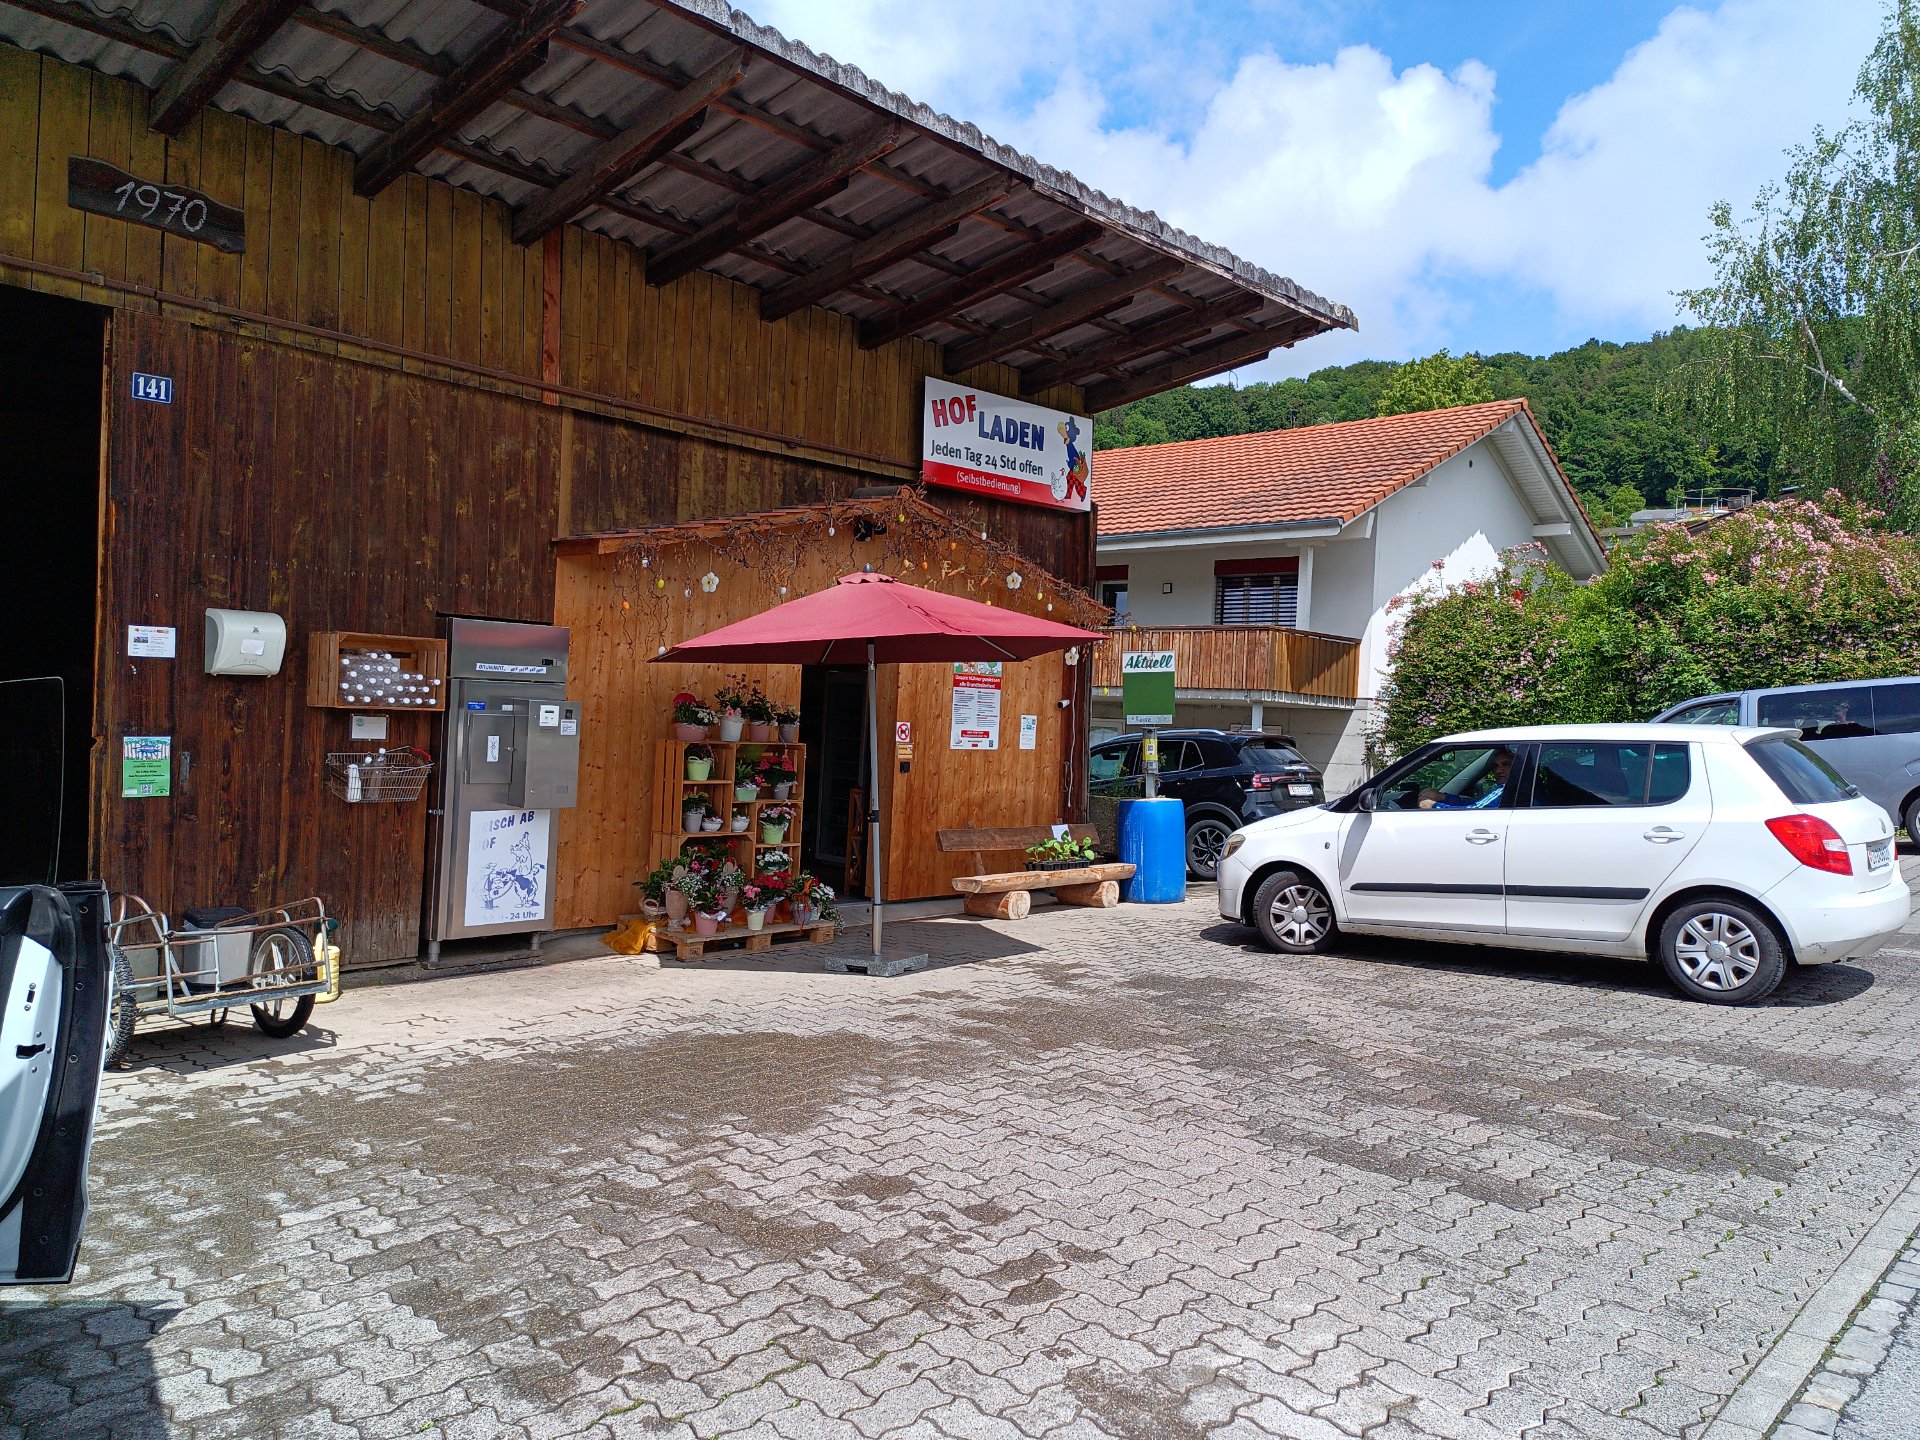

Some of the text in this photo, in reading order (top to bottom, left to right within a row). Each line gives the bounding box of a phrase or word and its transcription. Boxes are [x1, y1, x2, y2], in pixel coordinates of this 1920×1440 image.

[115, 181, 208, 232] 1970
[137, 376, 167, 400] 141
[931, 394, 977, 428] HOF
[978, 410, 1045, 452] LADEN
[931, 439, 1043, 476] Jeden Tag 24 Std offen
[956, 470, 1021, 494] (Selbstbedienung)
[1124, 654, 1173, 670] Aktuell
[519, 810, 535, 825] AB
[479, 836, 497, 851] OF
[510, 912, 520, 920] 24
[523, 911, 539, 919] Uhr
